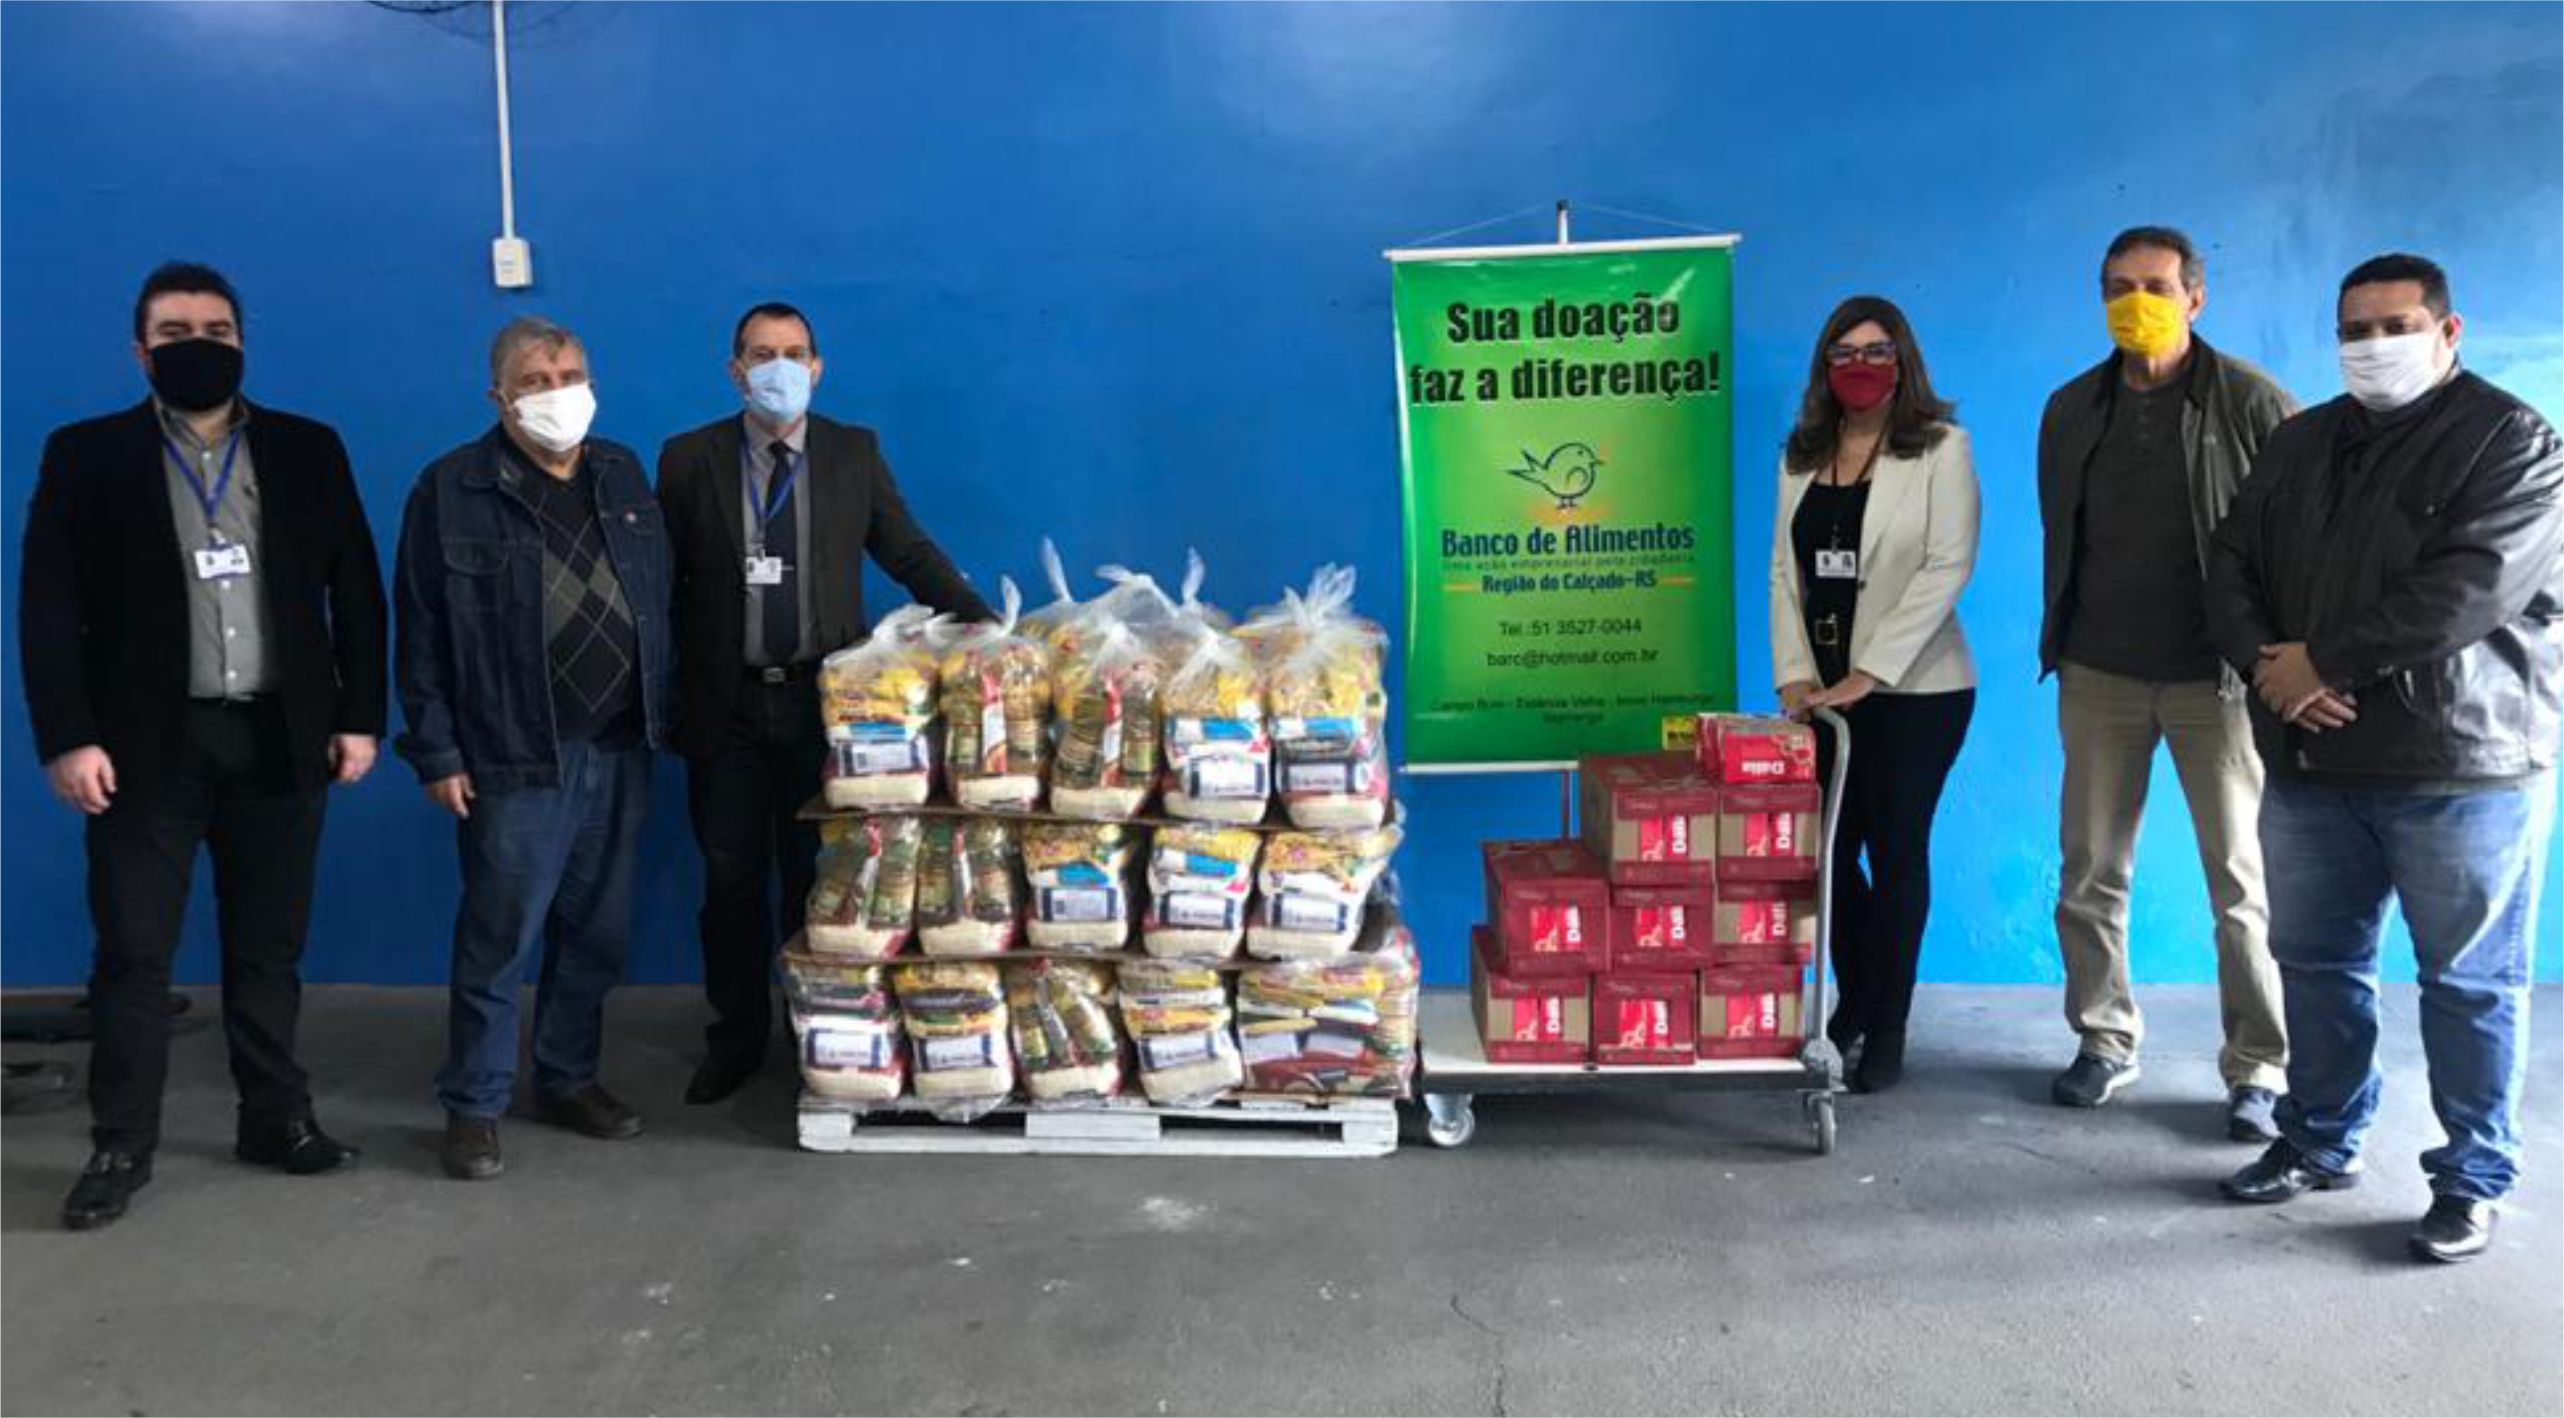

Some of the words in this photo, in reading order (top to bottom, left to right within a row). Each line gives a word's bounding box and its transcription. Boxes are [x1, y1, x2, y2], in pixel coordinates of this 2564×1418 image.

[1446, 303, 1520, 343] Sua
[1533, 291, 1680, 343] doação
[1410, 365, 1465, 404] faz
[1477, 368, 1499, 401] a
[1511, 352, 1720, 401] diferença!
[1442, 528, 1519, 558] Banco
[1527, 527, 1557, 555] de
[1566, 523, 1695, 554] Alimentos
[1482, 574, 1535, 594] Região
